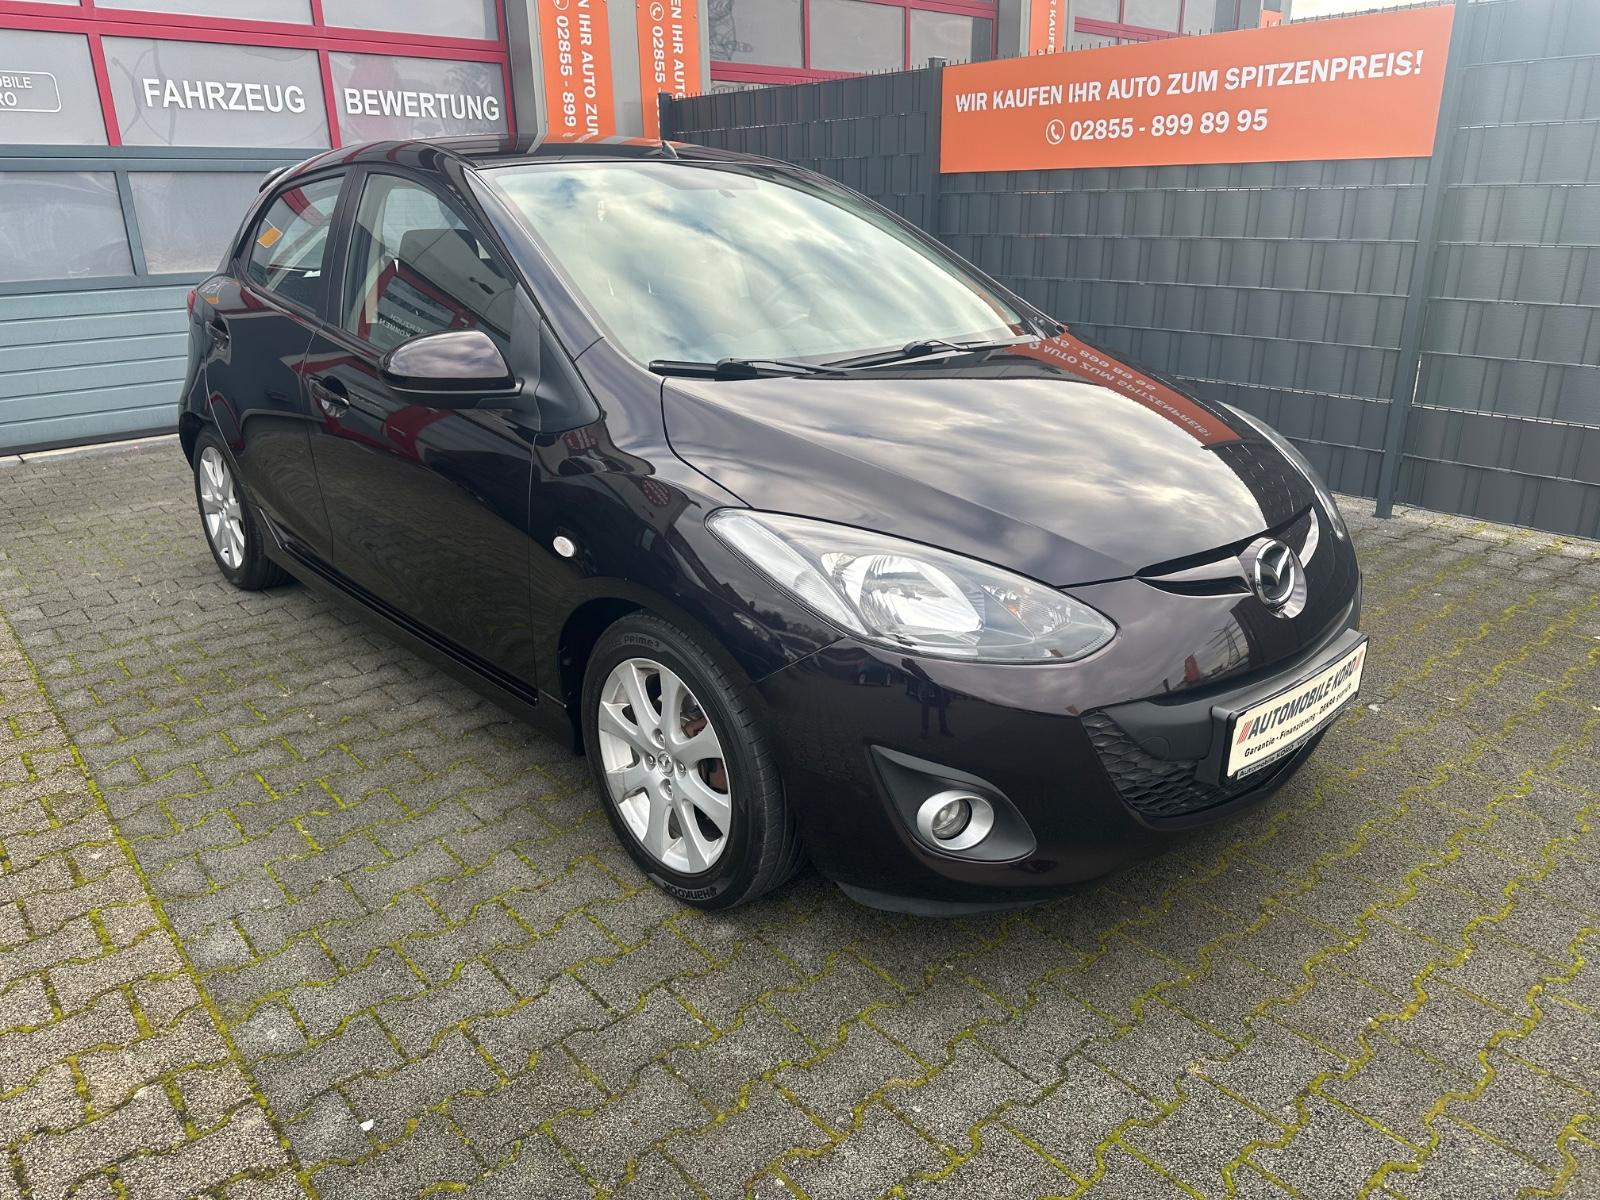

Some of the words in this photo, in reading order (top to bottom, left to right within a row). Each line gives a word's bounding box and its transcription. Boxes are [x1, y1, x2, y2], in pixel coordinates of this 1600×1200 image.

[556, 15, 573, 76] 02855
[578, 14, 592, 46] IHR
[671, 24, 684, 54] IHR
[652, 26, 666, 83] 02855
[0, 75, 33, 89] BILE
[581, 50, 596, 99] AUTO
[955, 92, 988, 113] WIR
[992, 85, 1063, 110] KAUFEN
[1068, 81, 1102, 103] IHR
[1106, 75, 1161, 100] AUTO
[1166, 69, 1219, 95] ZUM
[1224, 49, 1424, 91] SPITZENPREIS!
[142, 78, 306, 113] FAHRZEUG
[343, 87, 500, 121] BEWERTUNG
[562, 91, 577, 127] 899
[1070, 117, 1134, 141] 02855
[1151, 113, 1194, 137] 899
[1199, 110, 1230, 134] 89
[1236, 108, 1269, 132] 95
[1247, 675, 1333, 740] AUTOMOBILE
[1244, 737, 1275, 758] Garantie
[663, 882, 711, 900] Hankook
